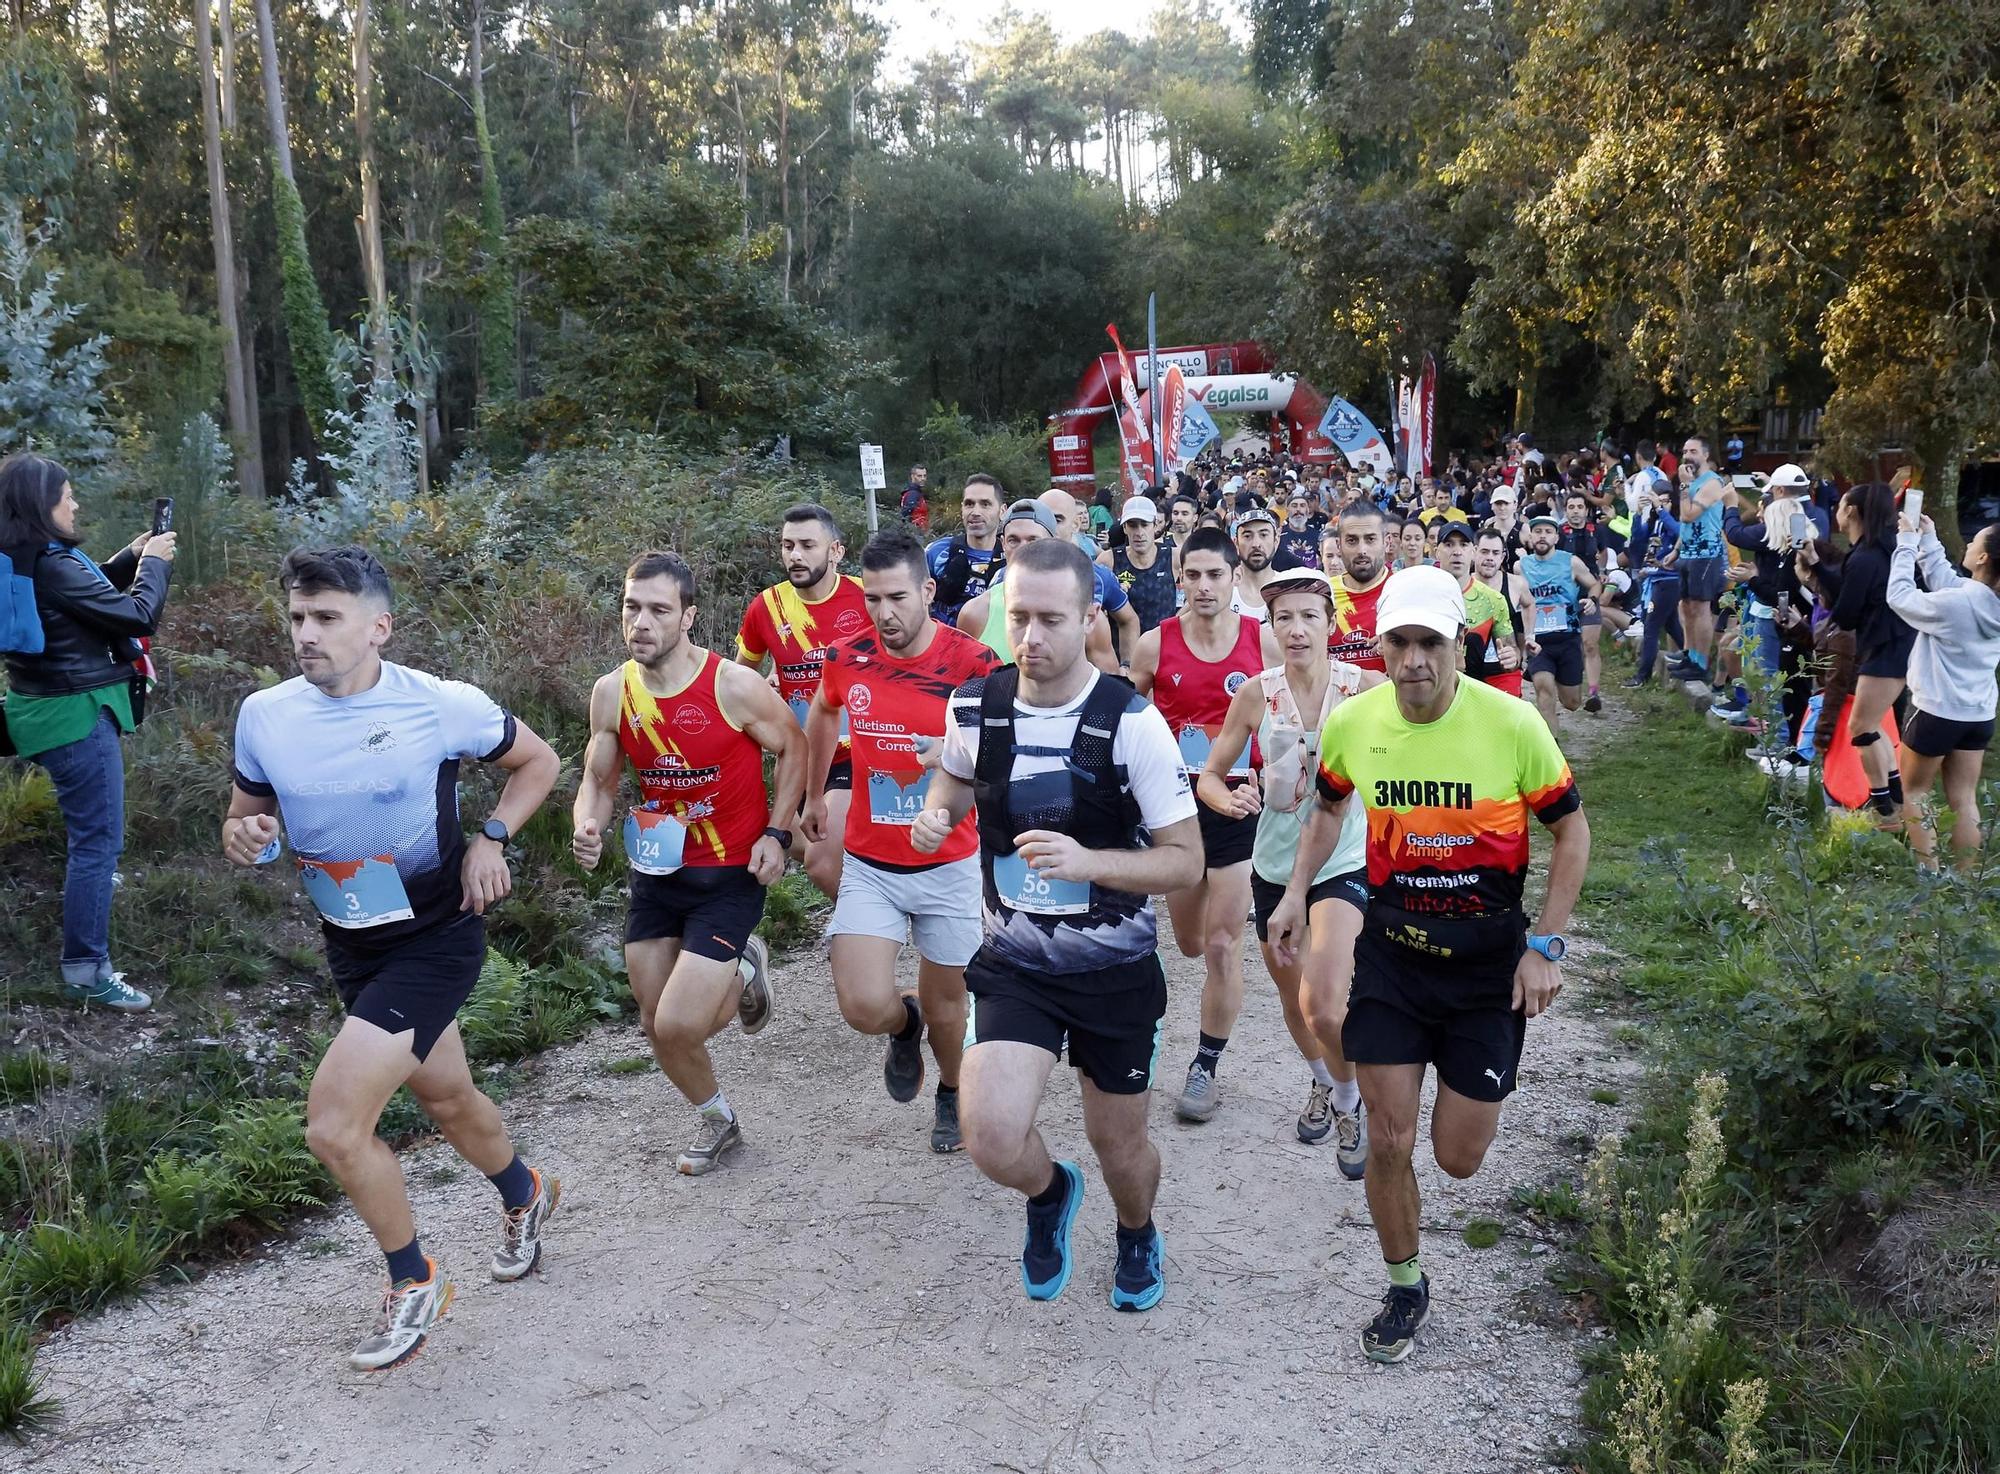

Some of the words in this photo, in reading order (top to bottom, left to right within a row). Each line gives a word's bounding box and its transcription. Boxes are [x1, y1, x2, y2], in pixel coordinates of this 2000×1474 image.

[1188, 383, 1269, 407] Vegalsa
[1171, 388, 1183, 453] EROSKI
[1346, 651, 1358, 659] de
[808, 670, 820, 679] de
[853, 718, 905, 733] Atletismo
[662, 777, 670, 787] de
[672, 774, 714, 787] LEONOR
[894, 795, 924, 811] 141
[1375, 780, 1473, 810] 3NORTH
[1406, 832, 1474, 848] Gasóleos
[635, 838, 660, 859] 124
[1405, 845, 1454, 860] Amigo
[1022, 873, 1051, 895] 56
[344, 892, 361, 911] 3
[1016, 892, 1057, 905] Alejandro
[346, 911, 369, 919] Borja
